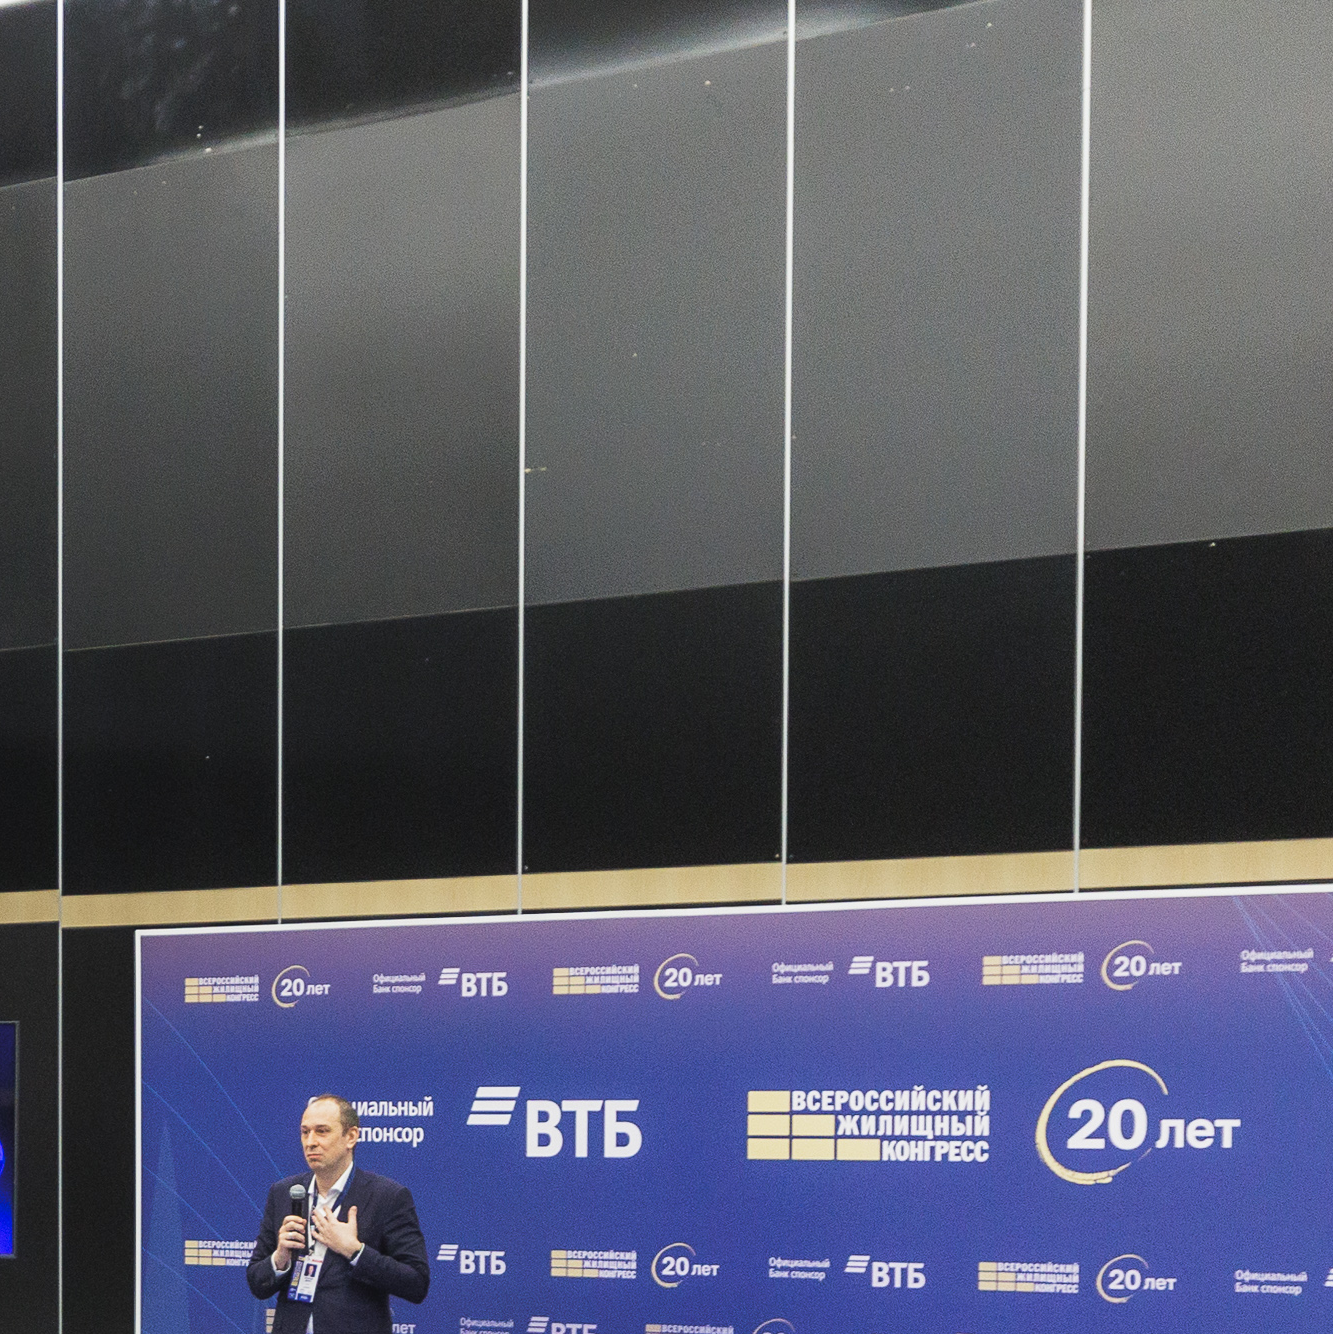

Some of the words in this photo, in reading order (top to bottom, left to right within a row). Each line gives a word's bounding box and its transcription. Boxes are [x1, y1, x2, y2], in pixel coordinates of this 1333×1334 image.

[1002, 952, 1084, 965] ВСЕРОССИЙСКИЙ
[1113, 955, 1145, 976] 20
[1148, 961, 1182, 975] лет
[570, 964, 639, 975] ВСЕРОССИЙСКИЙ
[875, 960, 930, 987] ВТБ
[1021, 963, 1084, 974] ЖИЛИЩНЫЙ
[461, 972, 508, 997] ВТБ
[585, 974, 639, 984] ЖИЛИЩНЫЙ
[665, 967, 692, 987] 20
[694, 972, 722, 986] лет
[1039, 974, 1083, 983] КОНГРЕСС
[281, 978, 304, 996] 20
[305, 982, 330, 995] лет
[601, 984, 639, 993] КОНГРЕСС
[351, 1096, 433, 1117] иальный
[792, 1086, 990, 1112] ВСЕРОССИЙСКИЙ
[526, 1100, 643, 1158] ВТБ
[837, 1110, 990, 1138] ЖИЛИЩНЫЙ
[1067, 1098, 1147, 1150] 20
[1155, 1118, 1241, 1150] лет
[881, 1140, 990, 1162] КОНГРЕСС
[567, 1249, 637, 1260] ВСЕРОССИЙСКИЙ
[460, 1250, 506, 1275] ВТБ
[583, 1259, 637, 1270] ЖИЛИЩНЫЙ
[661, 1256, 689, 1276] 20
[691, 1262, 720, 1276] лет
[997, 1261, 1079, 1273] ВСЕРОССИЙСКИЙ
[599, 1269, 636, 1279] КОНГРЕСС
[872, 1262, 926, 1288] ВТБ
[1016, 1272, 1079, 1284] ЖИЛИЩНЫЙ
[1109, 1269, 1141, 1290] 20
[1143, 1276, 1176, 1291] лет
[1235, 1270, 1307, 1283] Официальный
[1034, 1282, 1079, 1293] КОНГРЕСС
[1235, 1282, 1258, 1293] Банк
[1260, 1284, 1302, 1295] спонсор
[392, 1324, 416, 1334] лет
